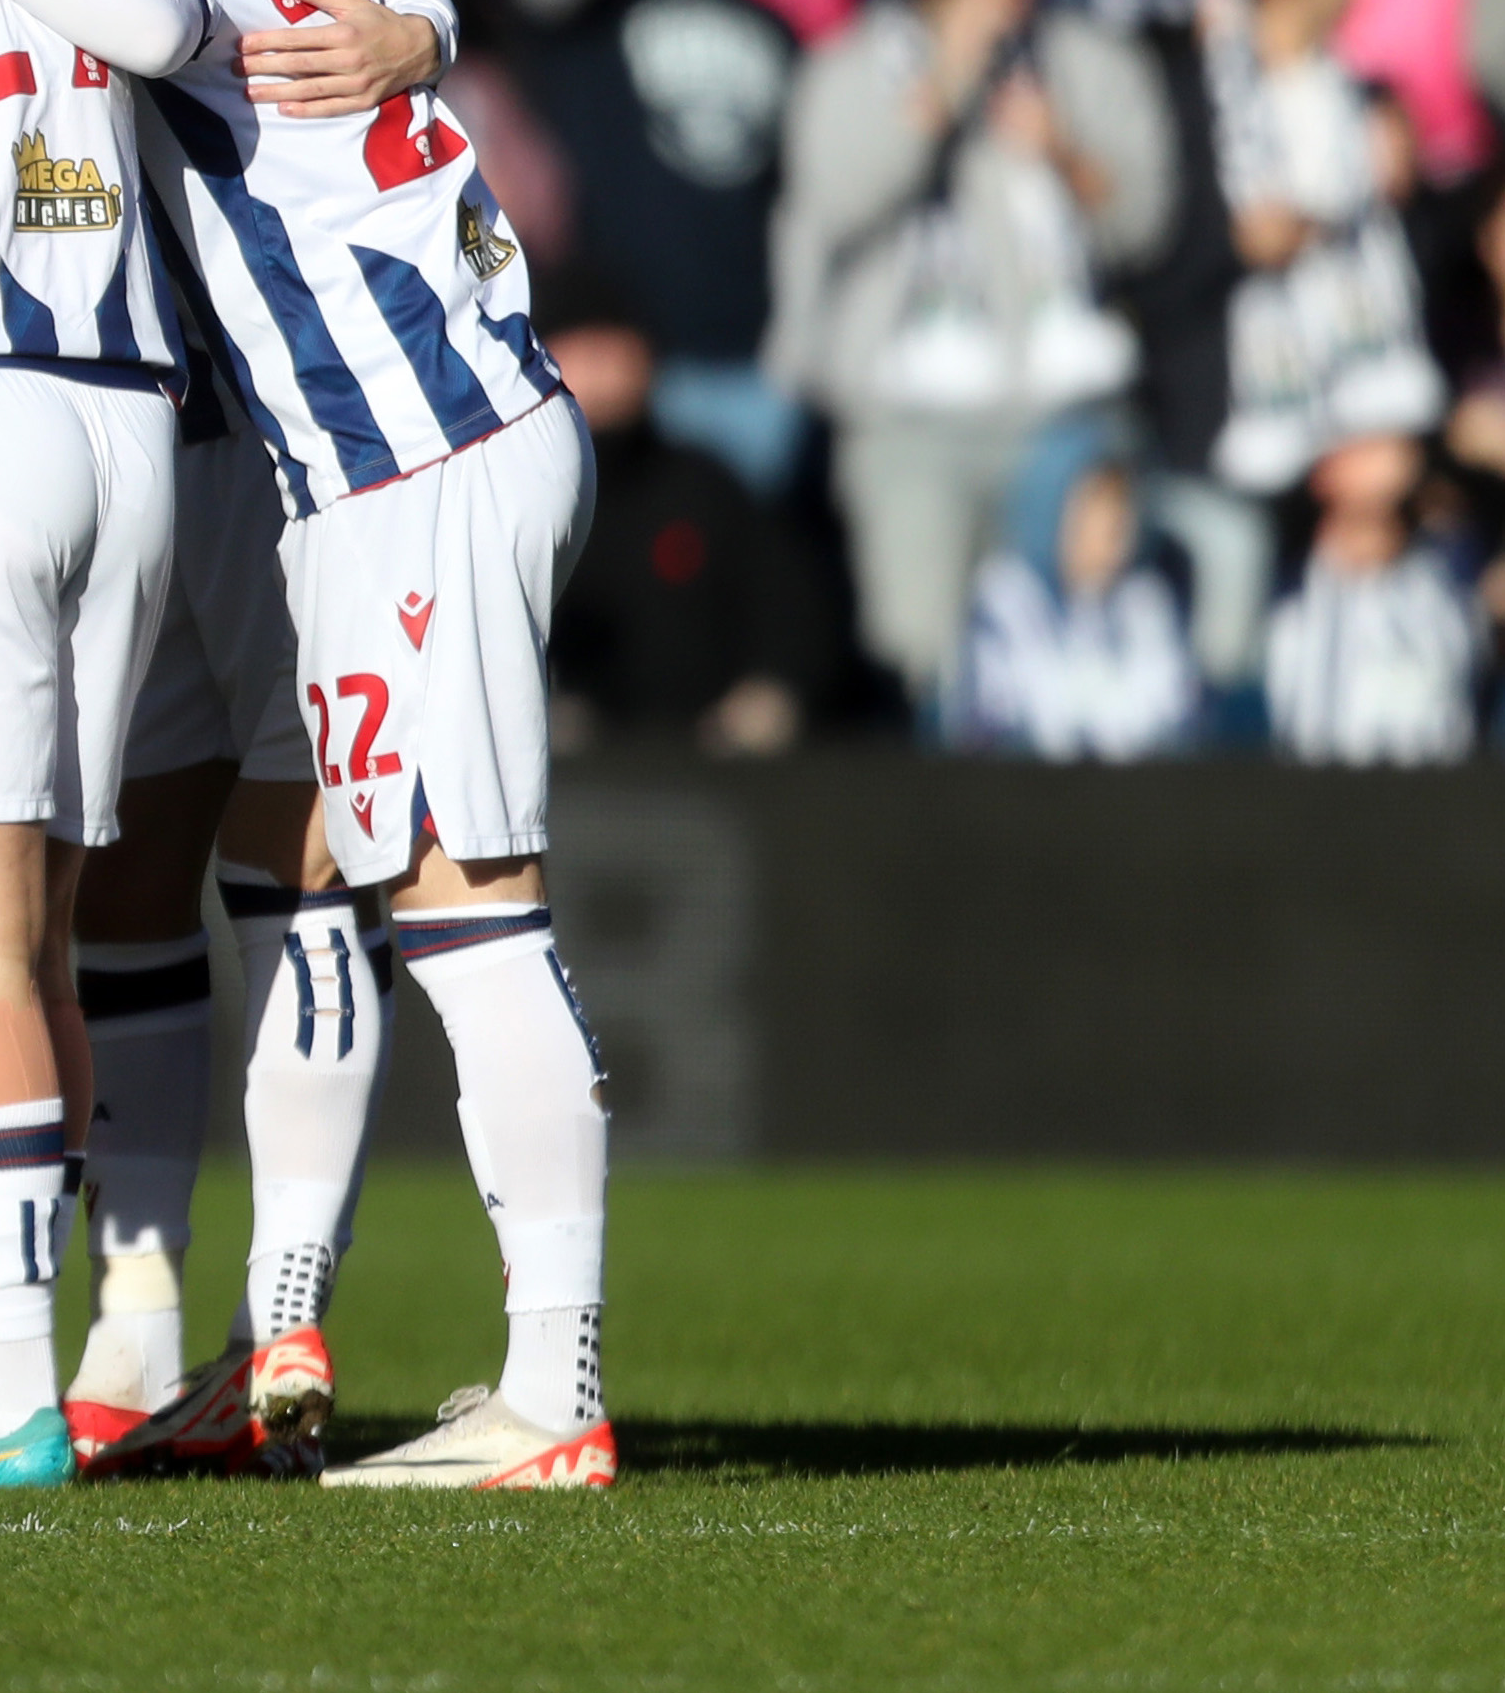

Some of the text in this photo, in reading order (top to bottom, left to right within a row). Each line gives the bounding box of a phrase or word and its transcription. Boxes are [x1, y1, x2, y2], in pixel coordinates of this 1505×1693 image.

[88, 71, 101, 82] EFL
[18, 158, 105, 191] MEGA
[16, 198, 107, 226] RICHES
[306, 672, 403, 789] 22
